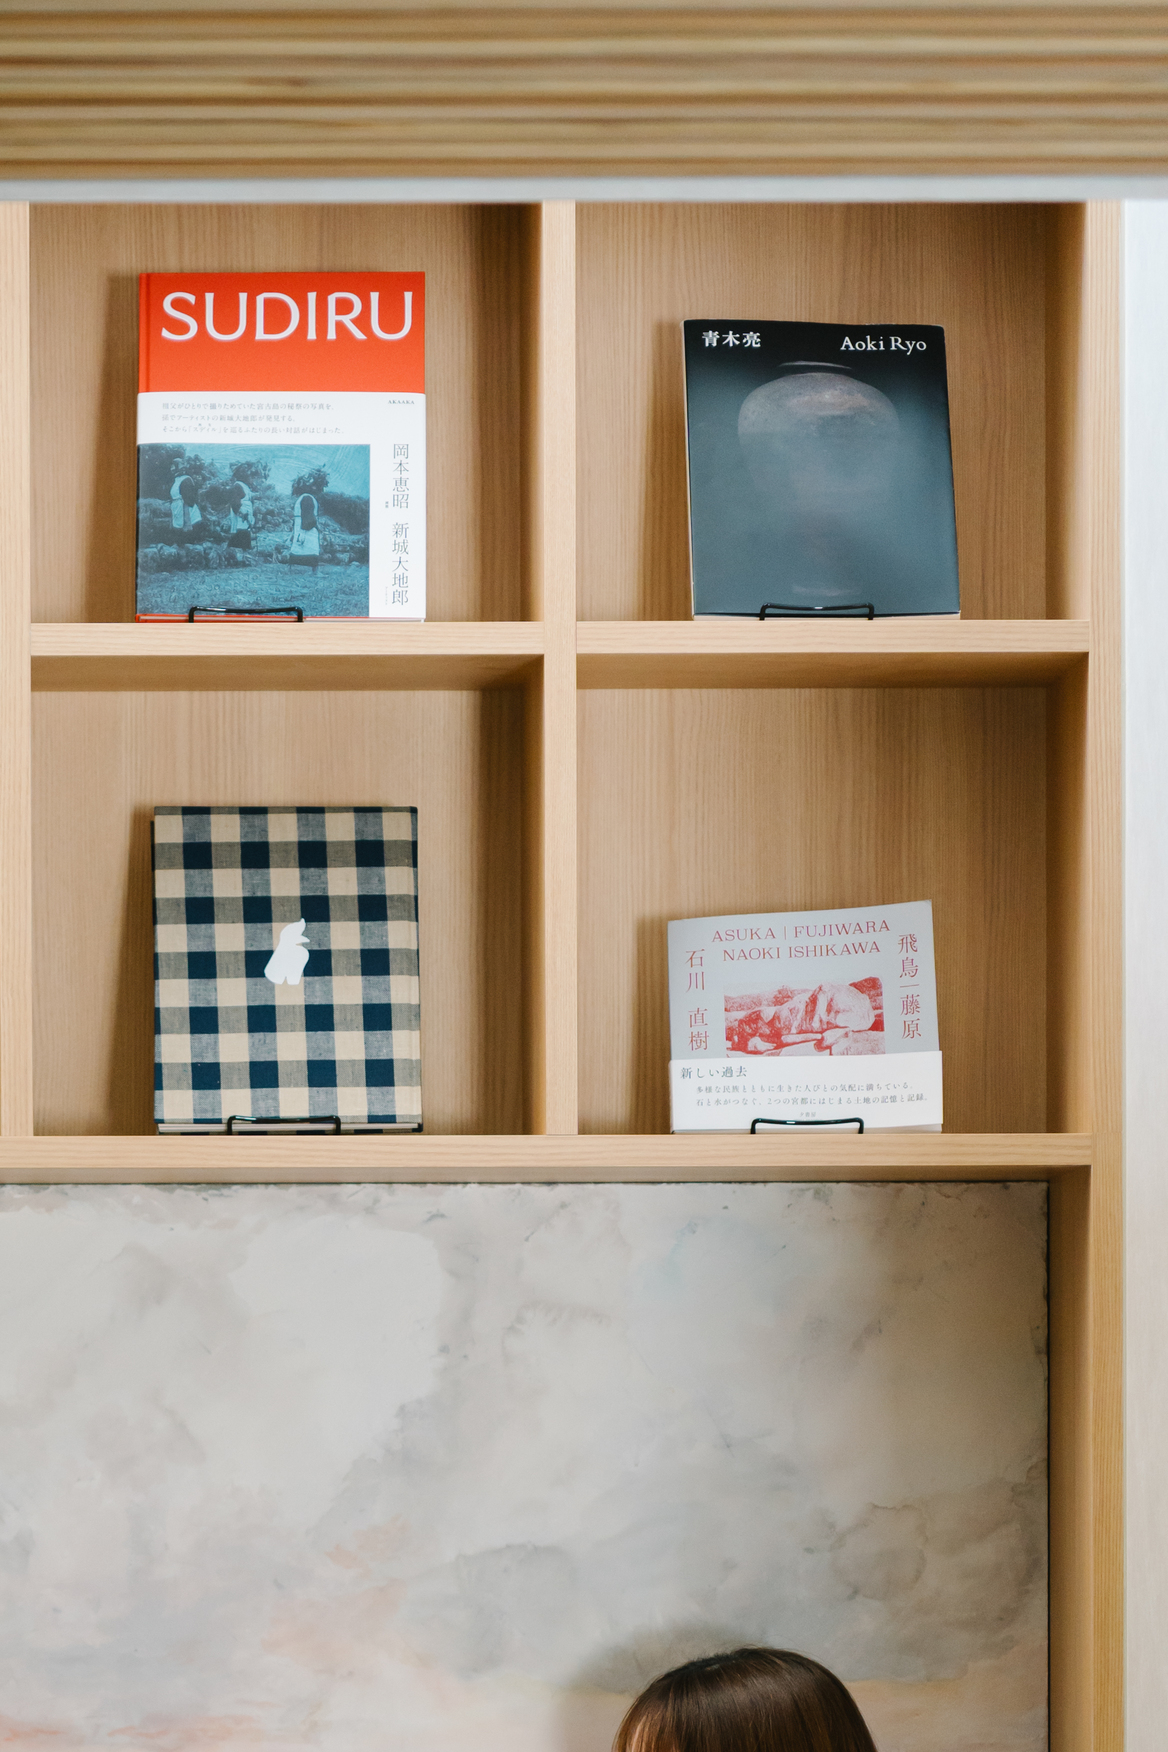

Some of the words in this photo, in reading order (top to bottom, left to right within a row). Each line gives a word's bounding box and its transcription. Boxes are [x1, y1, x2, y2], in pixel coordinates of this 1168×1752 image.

[161, 291, 413, 341] SUDIRU
[702, 330, 762, 348] 青木亮
[840, 335, 885, 351] Aoki
[890, 336, 927, 355] Ryo
[392, 443, 410, 510] 岡本恵昭
[391, 522, 410, 606] 新城大地郎
[711, 927, 777, 943] ASUKA
[794, 919, 891, 939] FUJIWARA
[722, 947, 781, 962] NAOKI
[788, 941, 882, 960] ISHIKAWA
[685, 948, 706, 993] 石川
[687, 1007, 710, 1052] 直樹
[680, 1065, 748, 1079] 新しい過去
